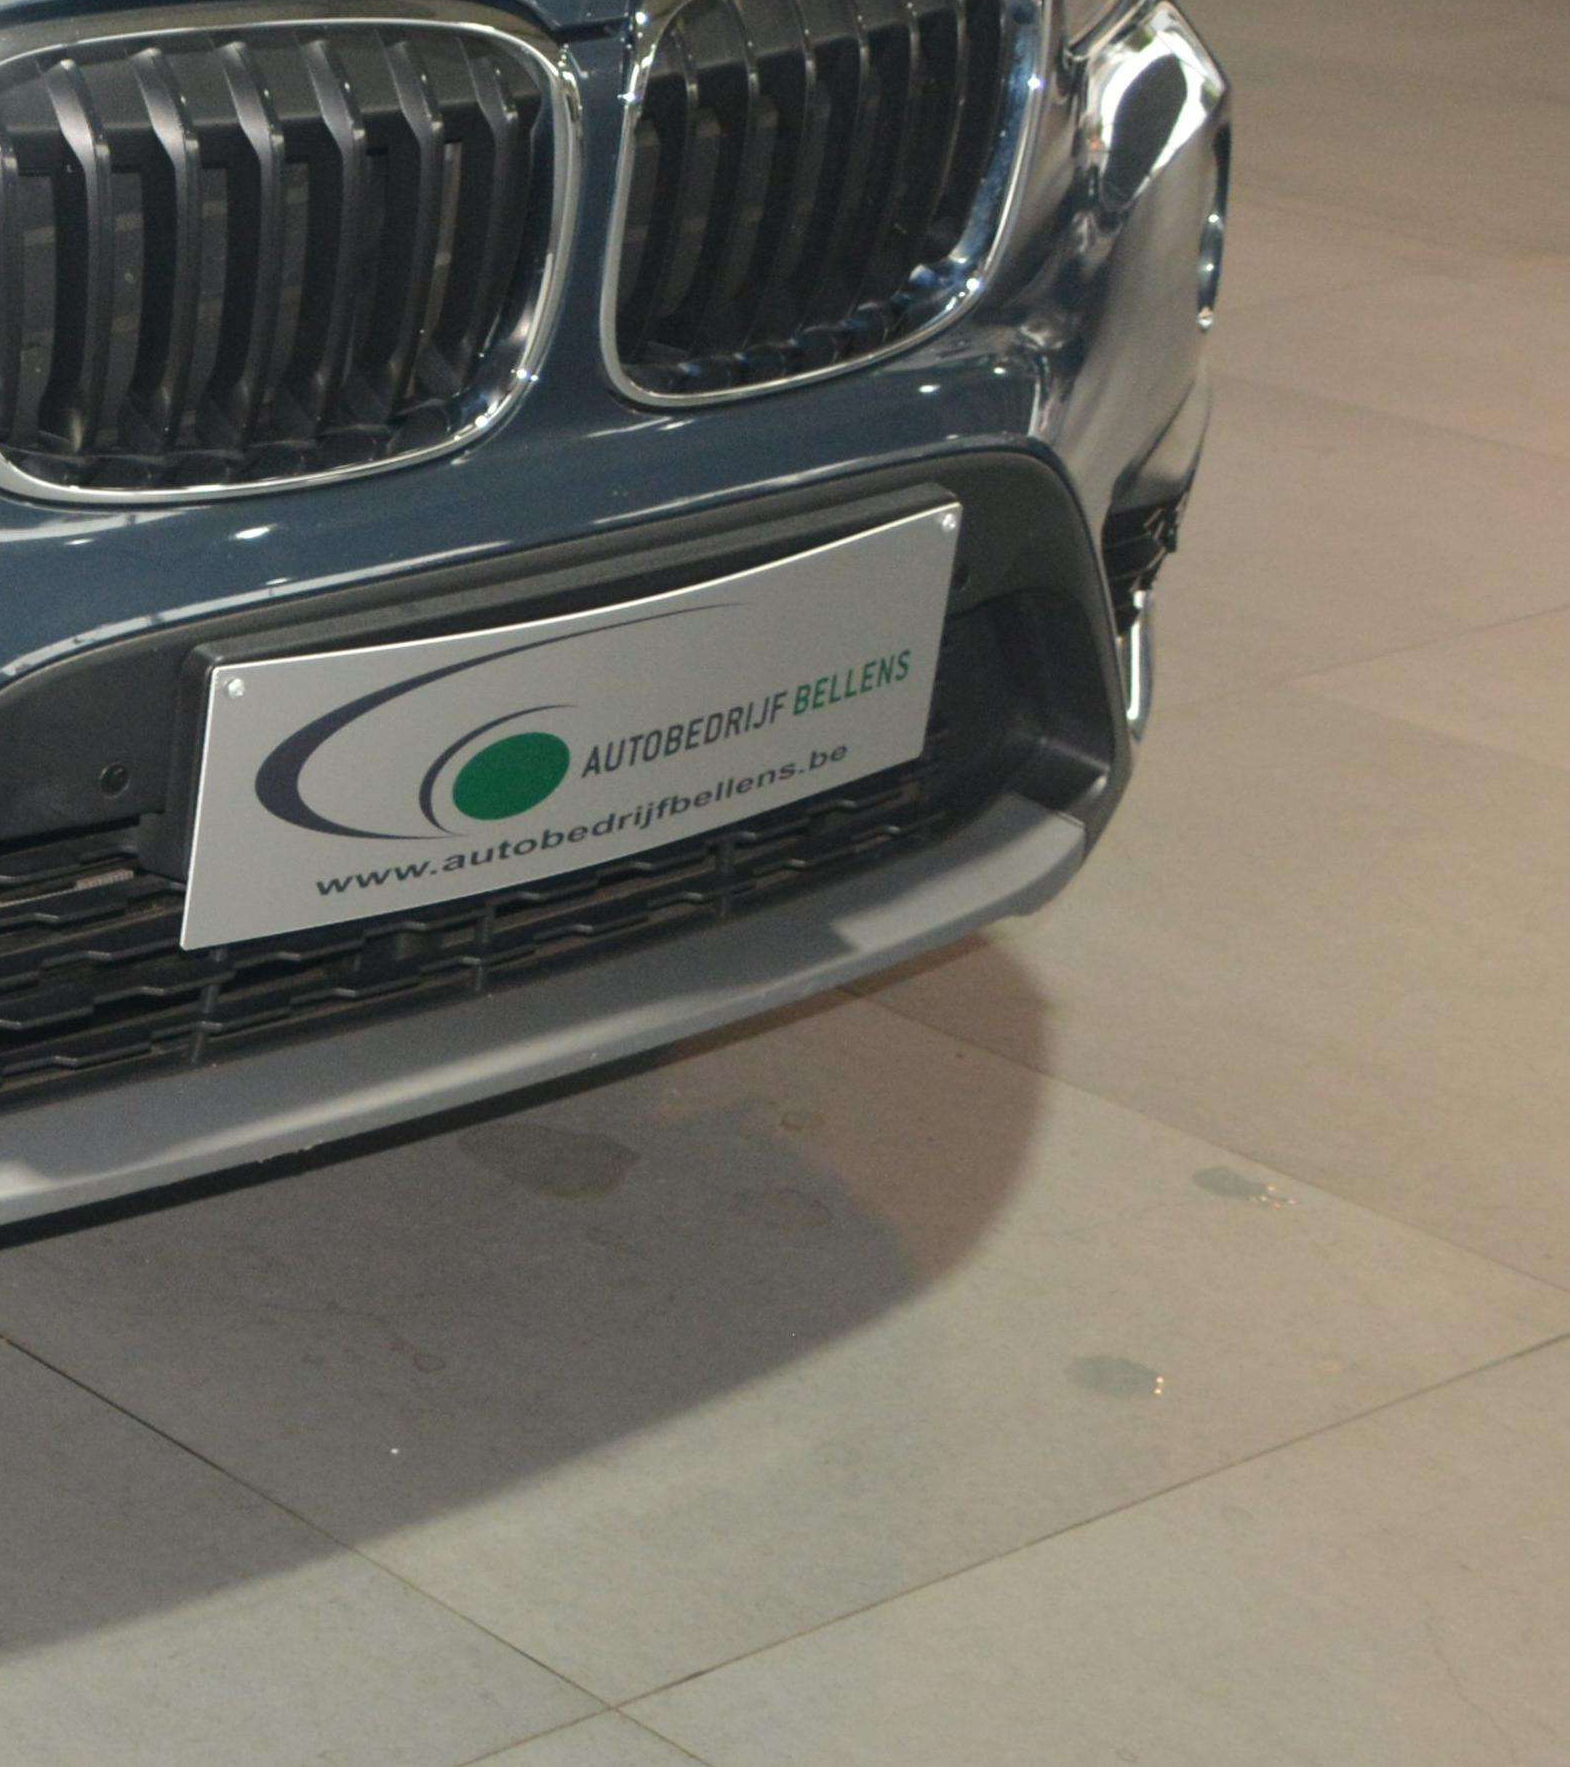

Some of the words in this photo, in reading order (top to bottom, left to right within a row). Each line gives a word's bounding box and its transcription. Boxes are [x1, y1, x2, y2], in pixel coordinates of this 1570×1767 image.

[581, 690, 788, 779] AUTOBEDRIJF
[792, 648, 912, 716] BELLENS
[315, 744, 849, 895] www.autobedrijfbellens.be
